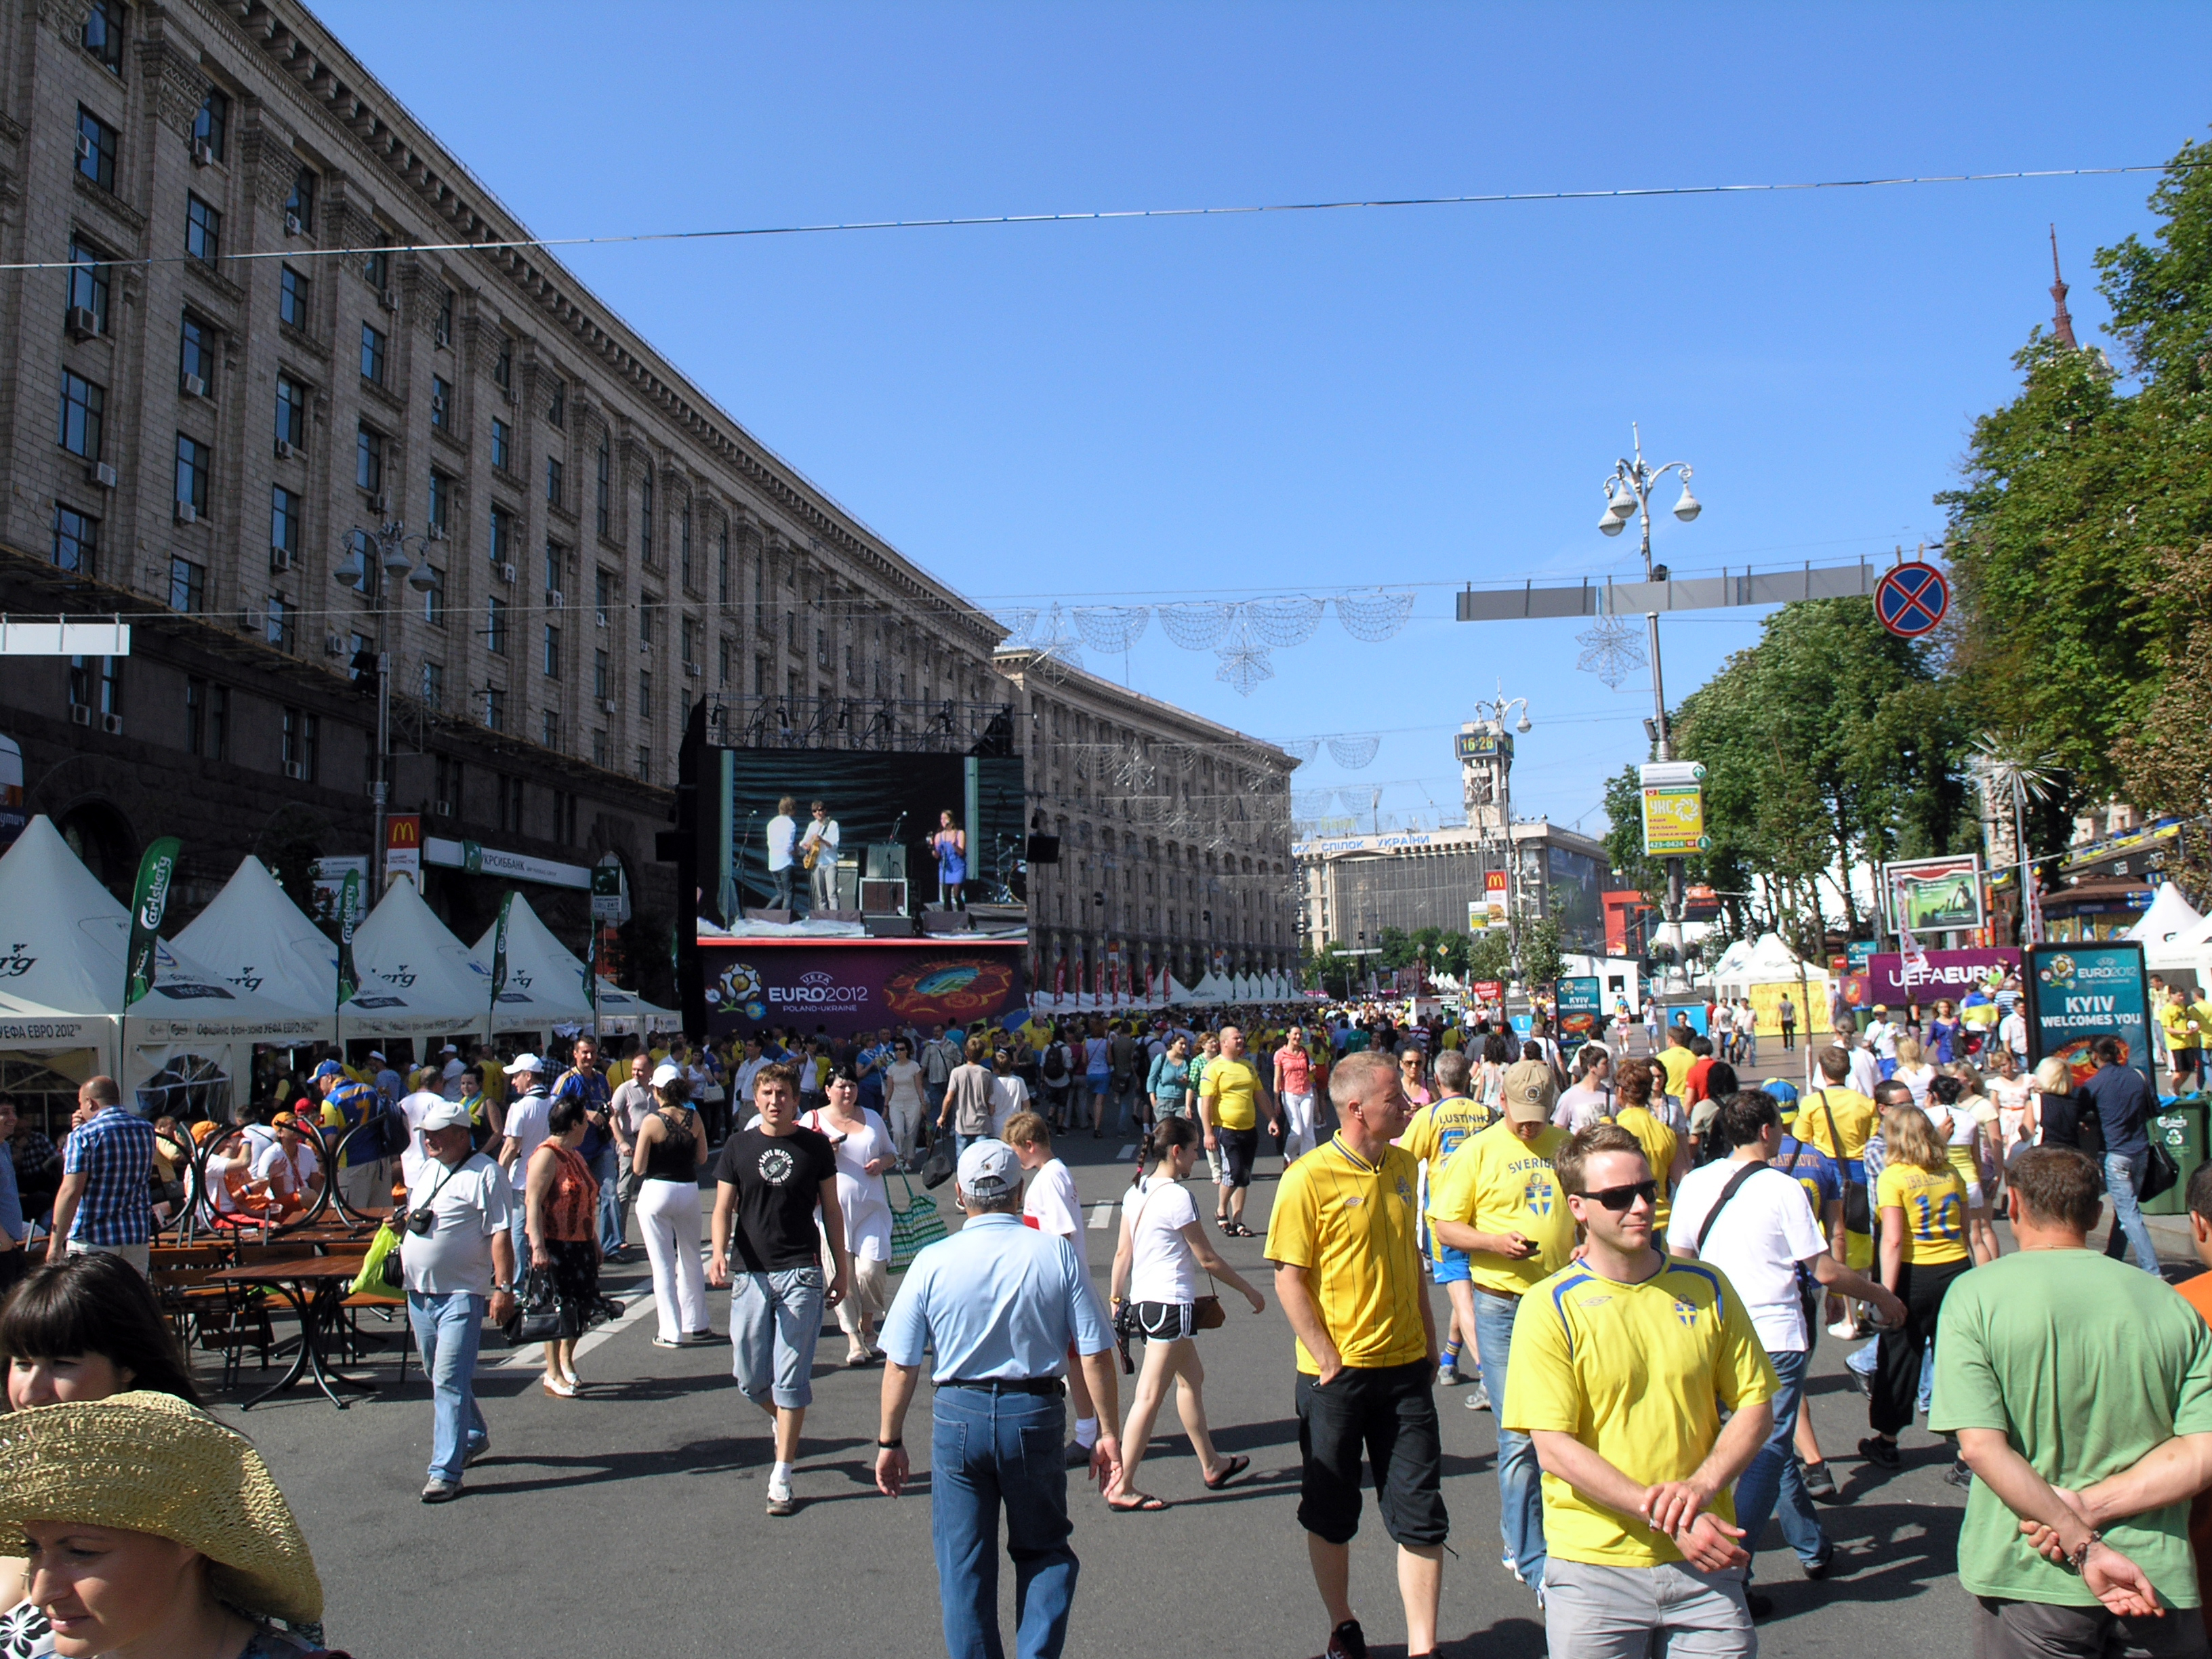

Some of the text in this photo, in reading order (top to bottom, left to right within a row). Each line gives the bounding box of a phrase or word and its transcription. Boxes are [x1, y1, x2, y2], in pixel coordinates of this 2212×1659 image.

[1462, 736, 1494, 752] 16:28
[1322, 840, 1365, 852] СПІЛОК
[1377, 834, 1430, 847] УКРАЇНИ
[140, 856, 172, 930] Carlsberg
[802, 973, 830, 983] UEFA
[769, 986, 868, 1002] EURO2012
[2065, 996, 2115, 1013] KYIV
[2041, 1012, 2142, 1027] WELCOMES YOU
[758, 1149, 794, 1165] SAVE WATER
